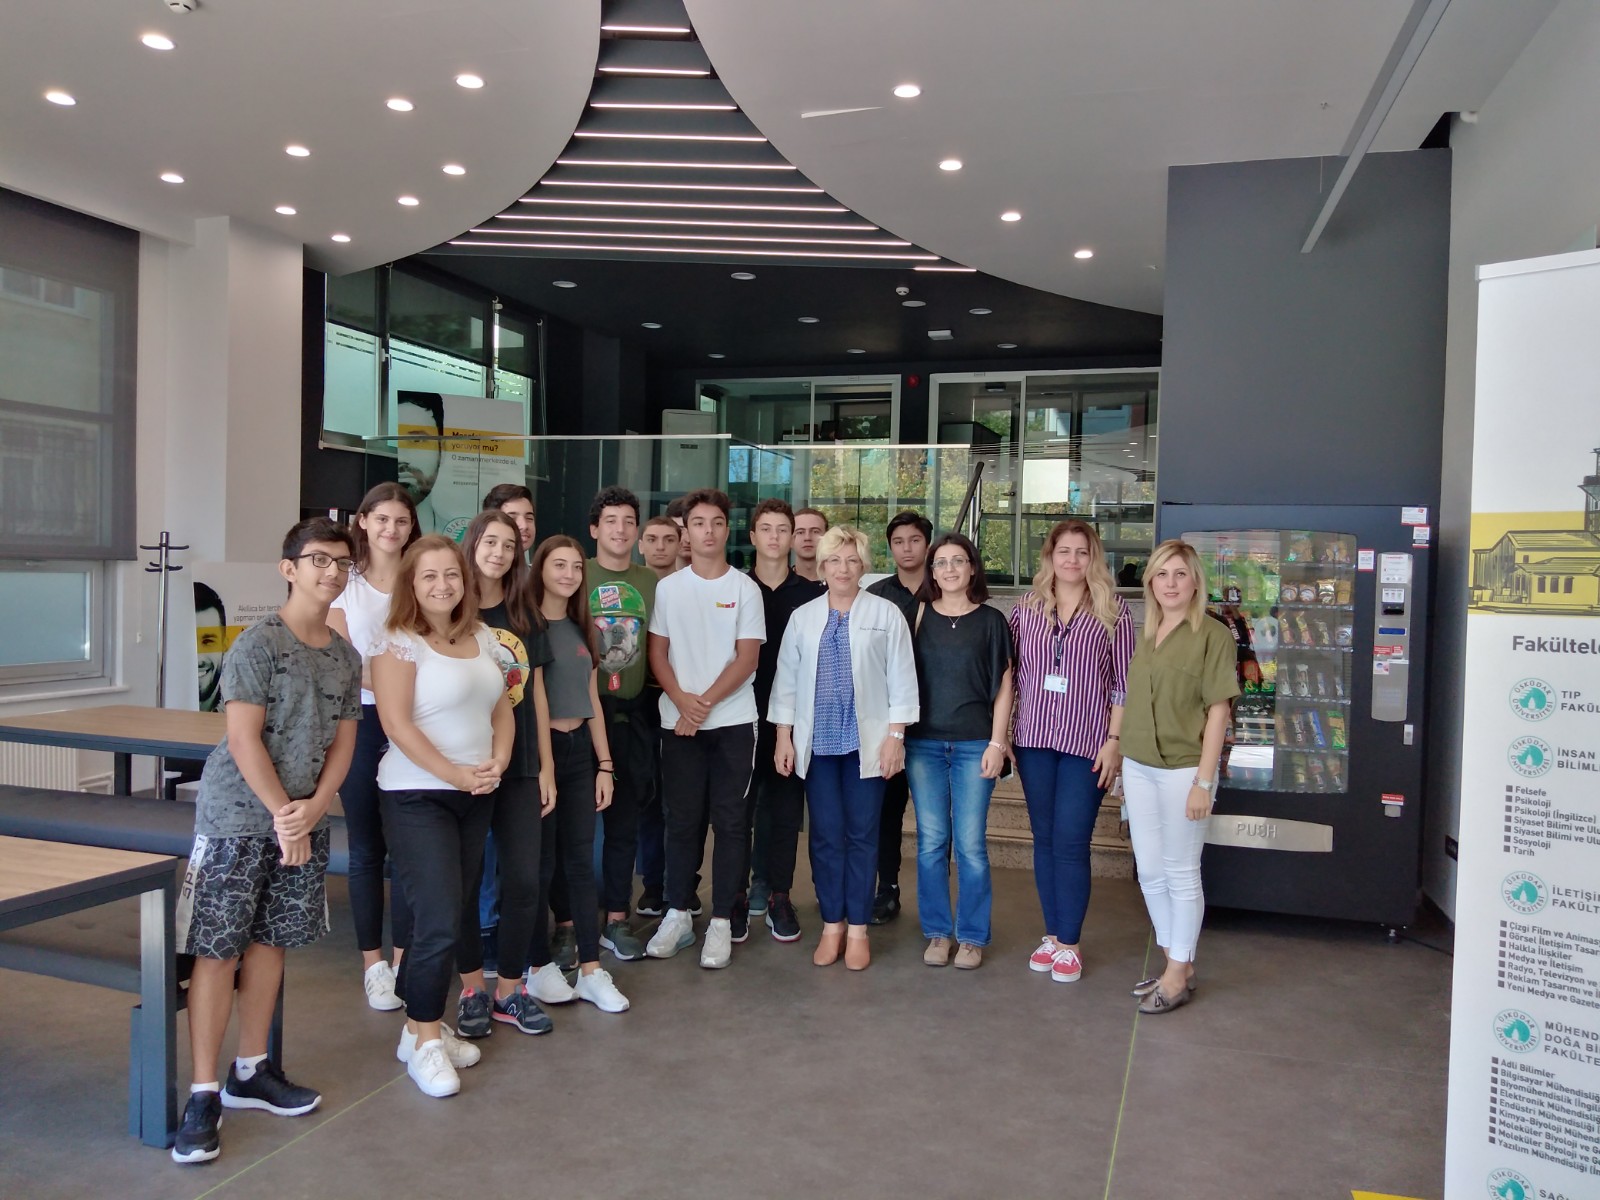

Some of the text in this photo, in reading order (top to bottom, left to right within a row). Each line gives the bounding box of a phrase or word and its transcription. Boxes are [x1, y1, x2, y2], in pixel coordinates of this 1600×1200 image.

[482, 444, 499, 452] mu?
[1512, 635, 1600, 655] Fakültel
[1560, 690, 1582, 700] TIP
[1560, 702, 1600, 713] FAKÜL
[1557, 747, 1596, 760] İNSAN
[1557, 759, 1600, 772] BİLİML
[1515, 785, 1547, 797] Felsefe
[1514, 795, 1552, 809] Psikoloji
[1513, 816, 1545, 828] Siyaset
[1546, 820, 1573, 831] Bilimi
[1574, 825, 1585, 833] ve
[1514, 806, 1597, 824] Psikoloji (İngilizce)
[1236, 821, 1278, 839] PUSH
[1513, 826, 1544, 837] Siyaset
[1546, 830, 1572, 841] Bilimi
[1573, 835, 1585, 843] ve
[1512, 846, 1535, 857] Tarih
[1513, 836, 1551, 850] Sosyoloji
[1551, 898, 1600, 914] FAKÜLT
[1509, 921, 1530, 933] Çizgi
[1531, 925, 1552, 936] Film
[1508, 931, 1537, 944] Görsel
[1538, 935, 1573, 951] İletişim
[1508, 941, 1573, 961] Halkla İlişkiler
[1508, 951, 1584, 974] Medya ve İletişim
[1507, 961, 1598, 988] Radyo, Televizyon ve
[1507, 971, 1540, 985] Reklam
[1541, 979, 1581, 994] Tasarımı
[1583, 990, 1595, 998] ve
[1506, 981, 1525, 993] Yeni
[1527, 986, 1556, 1000] Medya
[1557, 994, 1568, 1002] ve
[1545, 1021, 1600, 1041] MÜHEND
[1544, 1033, 1600, 1054] DOĞA Bİ
[1543, 1044, 1600, 1067] FAKÜLTE
[1500, 1058, 1556, 1079] Adli Bilimler
[1500, 1068, 1544, 1087] Bilgisayar
[1499, 1078, 1572, 1105] Biyomühendislik
[1499, 1088, 1545, 1108] Elektronik
[1499, 1098, 1536, 1115] Endüstri
[1538, 1109, 1595, 1133] Mühendisliği
[1499, 1108, 1562, 1134] Kimya-Biyoloji
[1498, 1118, 1543, 1136] Moleküler
[1544, 1131, 1578, 1149] Biyoloji
[1579, 1143, 1590, 1152] ve
[1498, 1128, 1542, 1146] Moleküler
[1544, 1142, 1577, 1160] Biyoloji
[1579, 1154, 1590, 1163] ve
[1498, 1138, 1529, 1155] Yazılım
[1531, 1148, 1588, 1174] Mühendisliği
[1539, 1189, 1570, 1200] SAĞ
